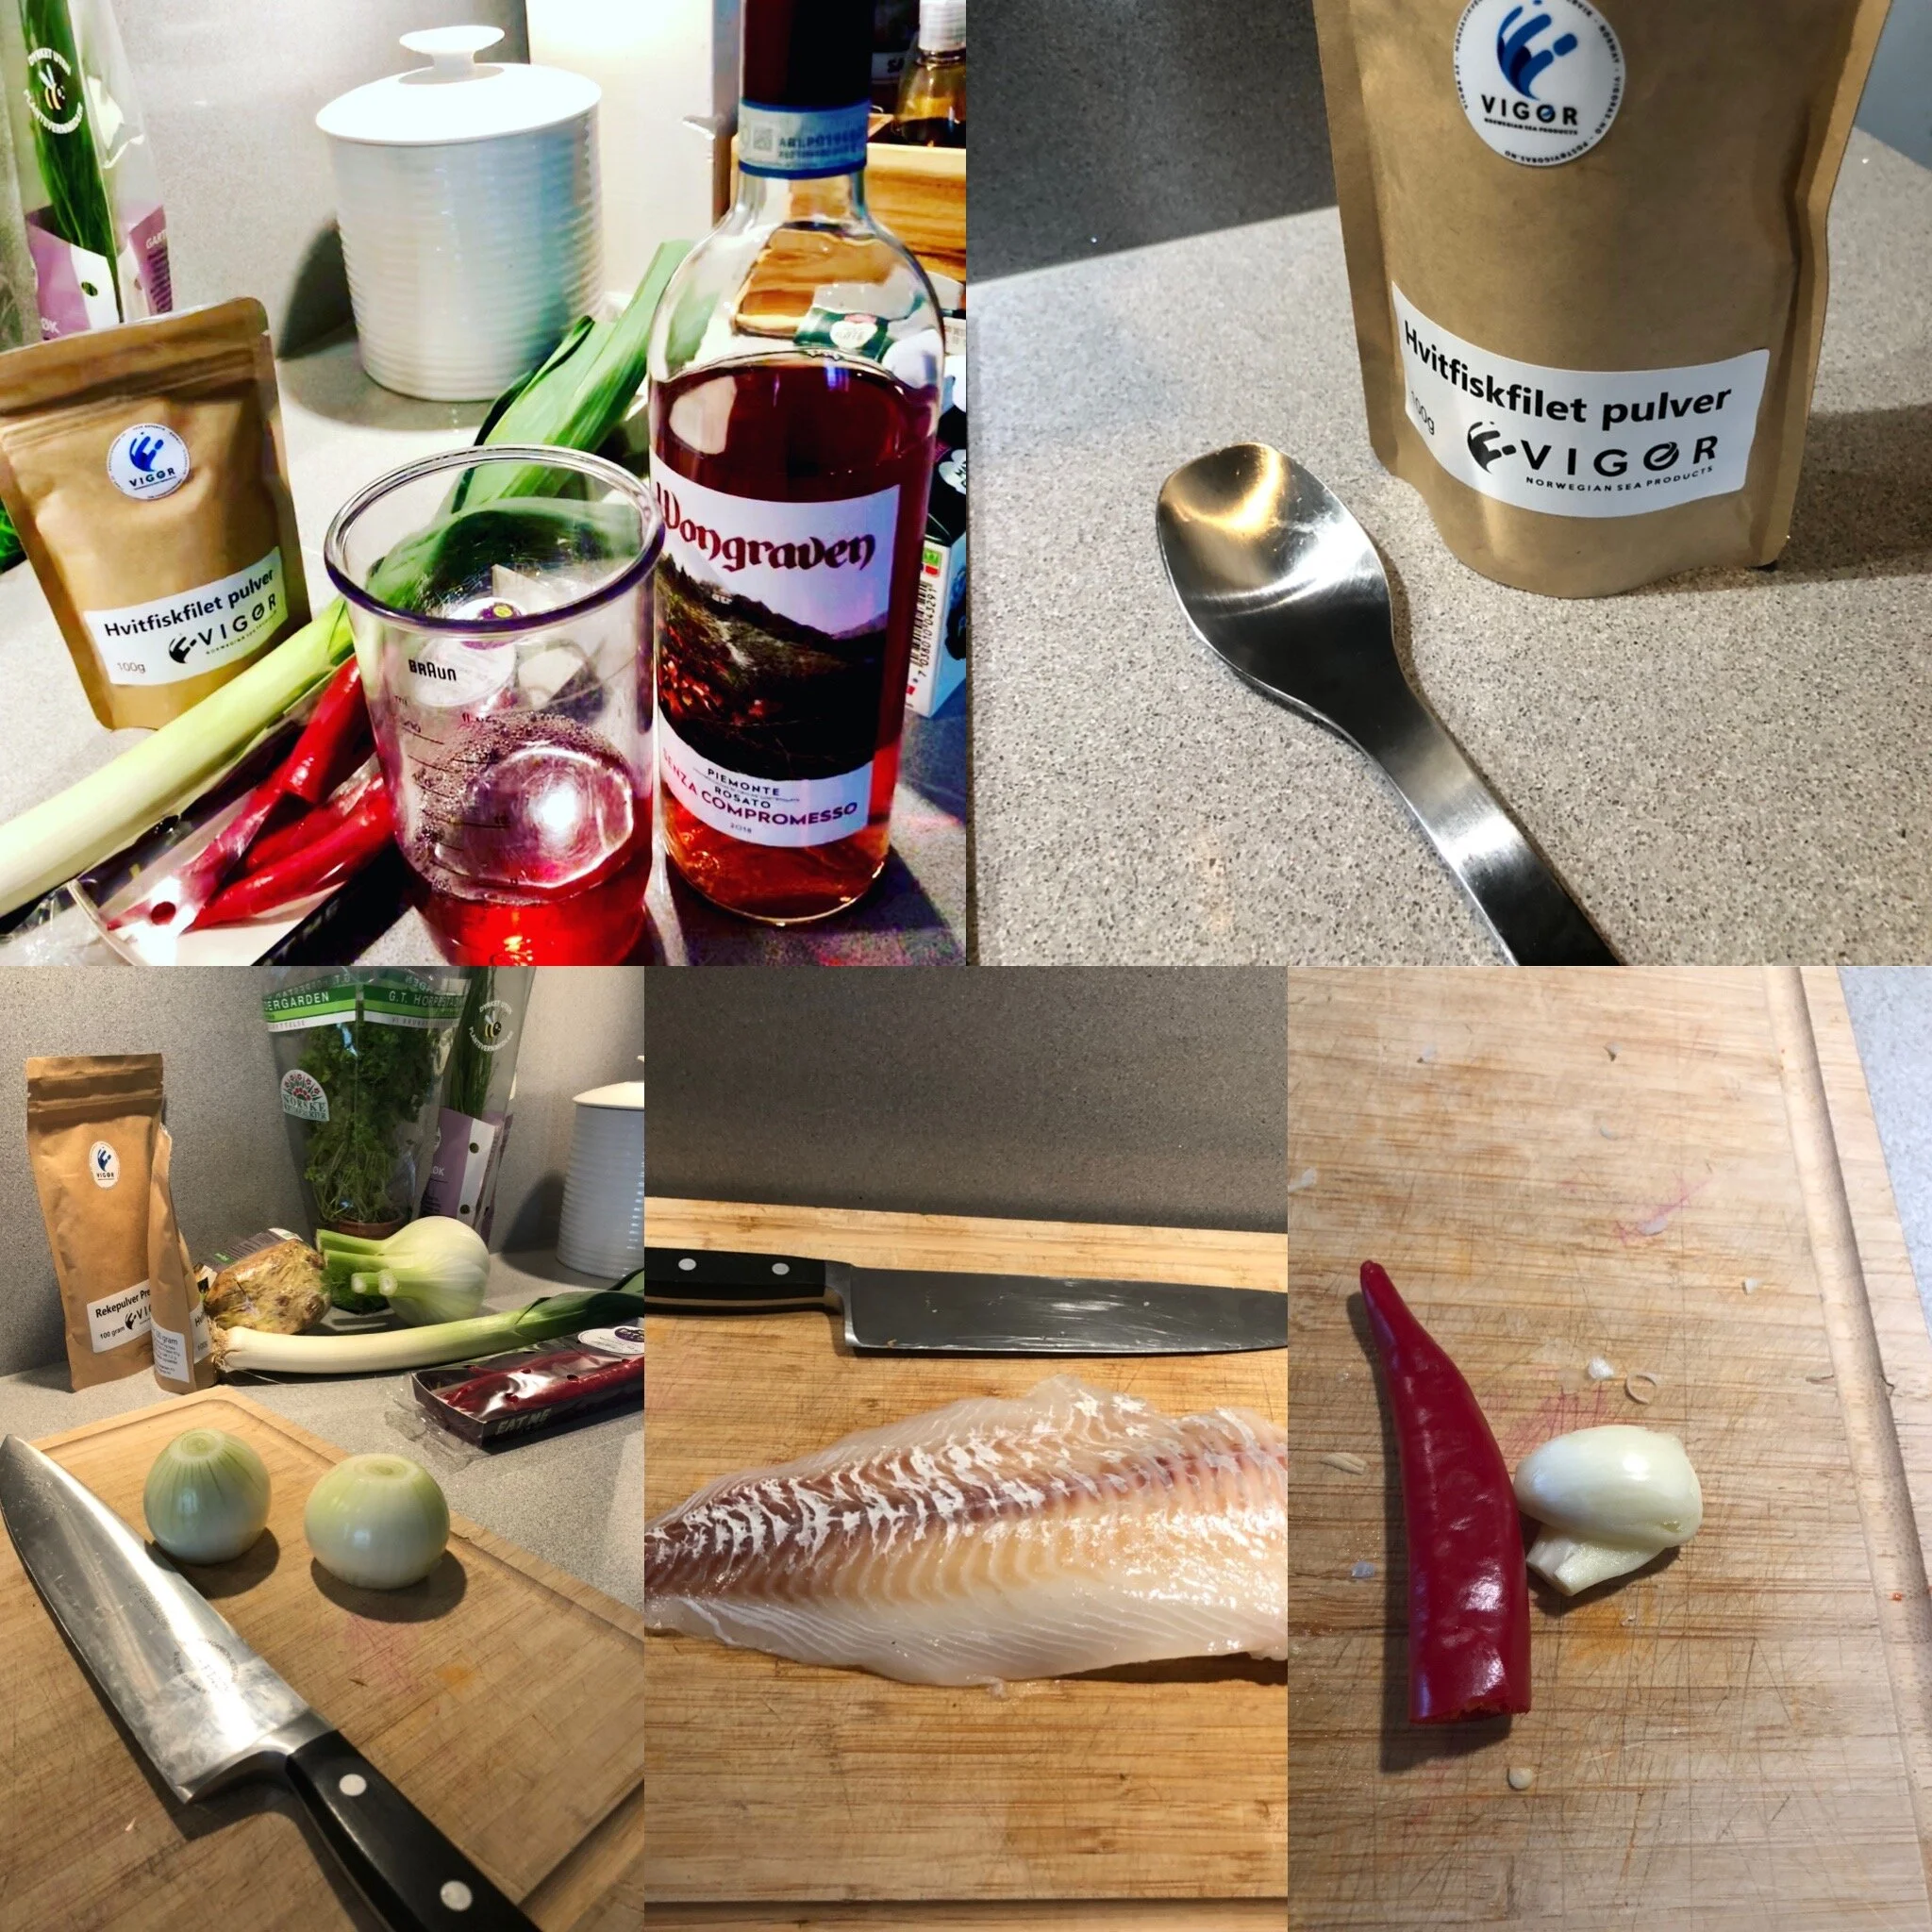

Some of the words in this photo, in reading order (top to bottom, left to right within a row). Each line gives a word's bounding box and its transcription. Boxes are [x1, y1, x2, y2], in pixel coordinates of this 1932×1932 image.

[1405, 320, 1587, 424] Hvitfiskfilet
[1603, 386, 1732, 432] pulver
[1410, 390, 1435, 436] 100g
[1525, 476, 1612, 492] NORWEGIAN
[1617, 482, 1641, 491] SEA
[1646, 465, 1713, 488] PRODUCTS
[657, 481, 876, 573] Wongraven
[104, 596, 224, 638] Hvitfiskfilet
[227, 569, 274, 609] pulver
[117, 661, 146, 674] 100g
[662, 747, 698, 796] SENZA
[701, 790, 858, 826] COMPROMESSO
[708, 768, 780, 796] PIEMONTE
[715, 786, 772, 809] ROSATO
[95, 1294, 140, 1318] Rekepulver
[140, 1289, 151, 1300] Pre
[100, 1330, 110, 1340] 100
[112, 1326, 125, 1337] gram
